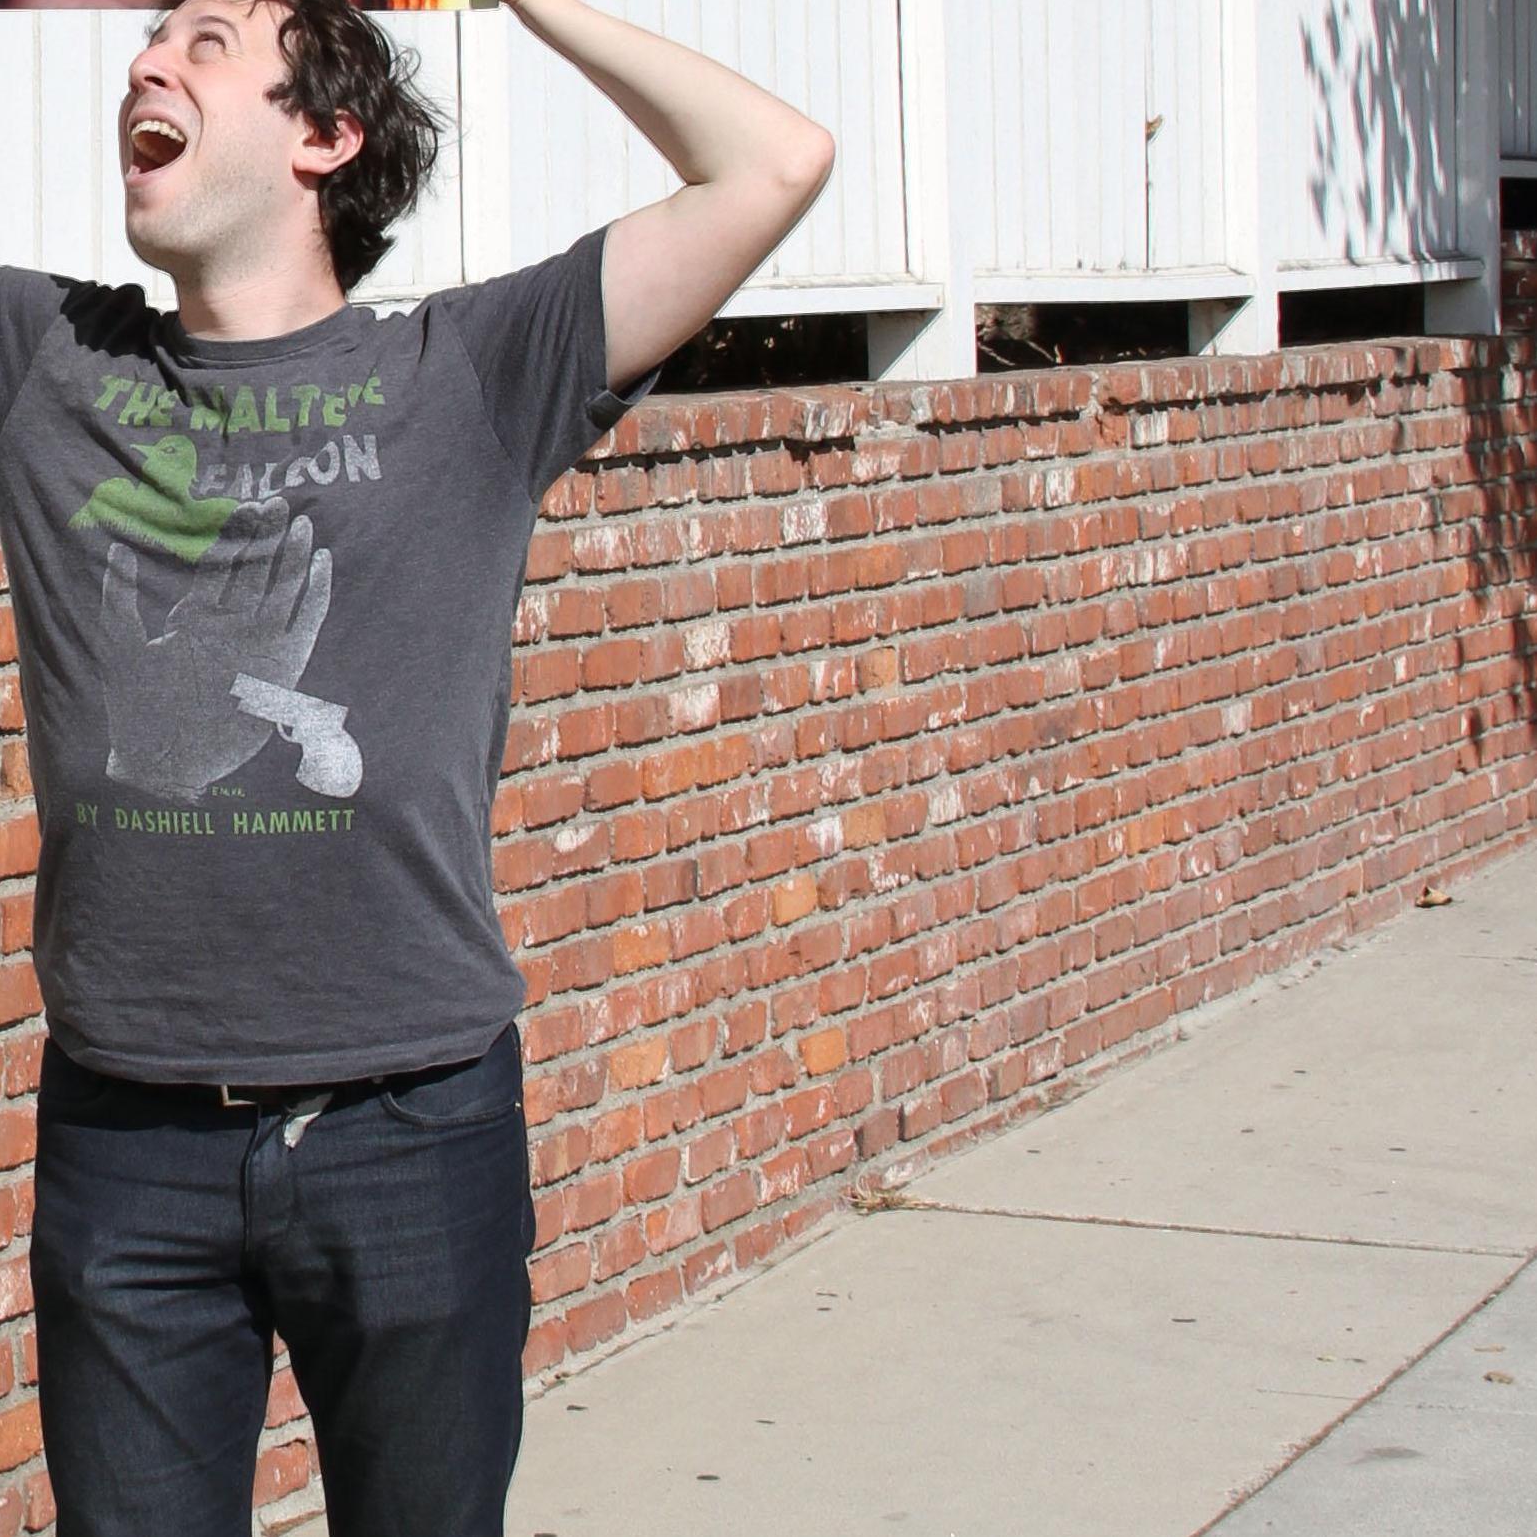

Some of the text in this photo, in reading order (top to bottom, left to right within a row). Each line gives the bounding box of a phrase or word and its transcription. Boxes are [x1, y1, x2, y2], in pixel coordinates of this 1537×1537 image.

[93, 374, 178, 426] THE
[76, 802, 355, 835] BY DASHIELL HAMMETT
